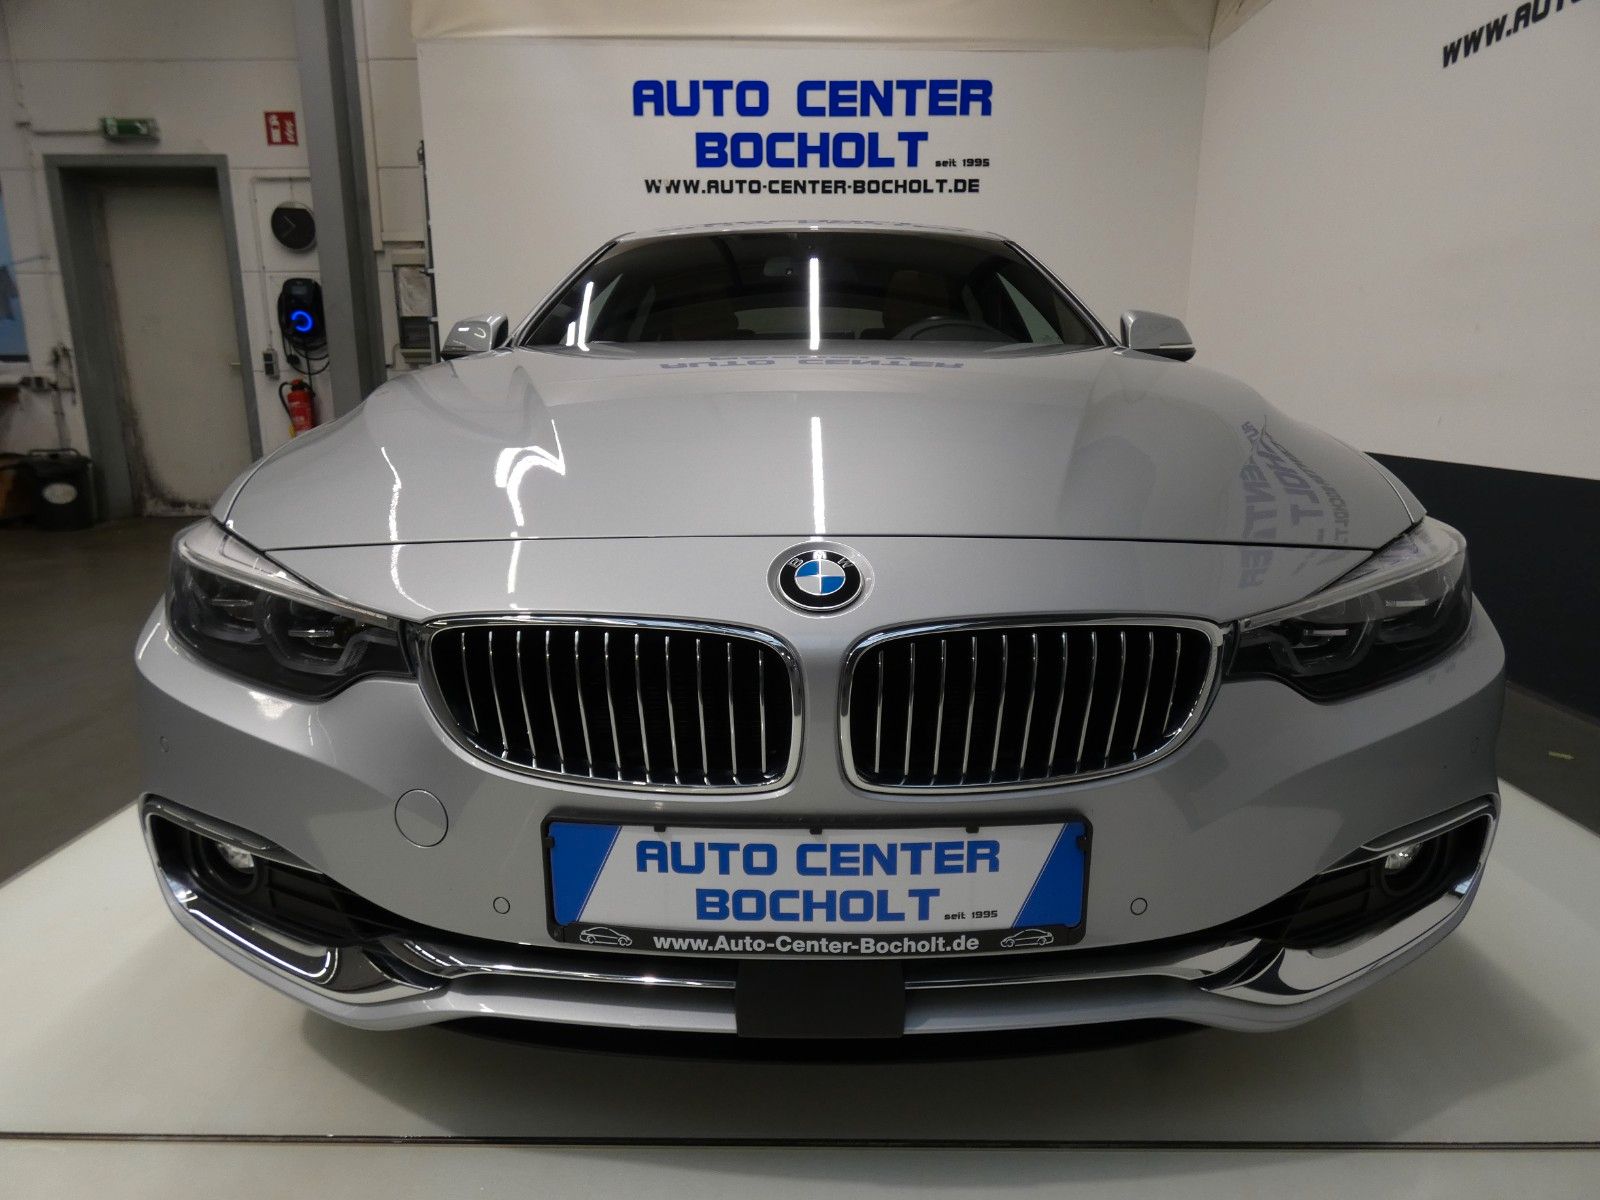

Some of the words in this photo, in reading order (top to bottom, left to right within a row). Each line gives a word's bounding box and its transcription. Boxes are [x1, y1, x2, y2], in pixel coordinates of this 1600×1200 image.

[632, 79, 769, 118] AUTO
[797, 79, 993, 118] CENTER
[695, 131, 929, 169] BOCHOLT
[935, 158, 957, 168] seit
[962, 157, 991, 168] 1995
[644, 178, 980, 195] WWW.AUTO-CENTER-BOCHOLT.DE
[636, 840, 778, 876] AUTO
[796, 839, 1000, 877] CENTER
[696, 888, 940, 923] BOCHOLT
[943, 910, 966, 921] seit
[971, 909, 999, 920] 1995
[652, 934, 980, 956] www.Auto-Center-Bocholt.de
